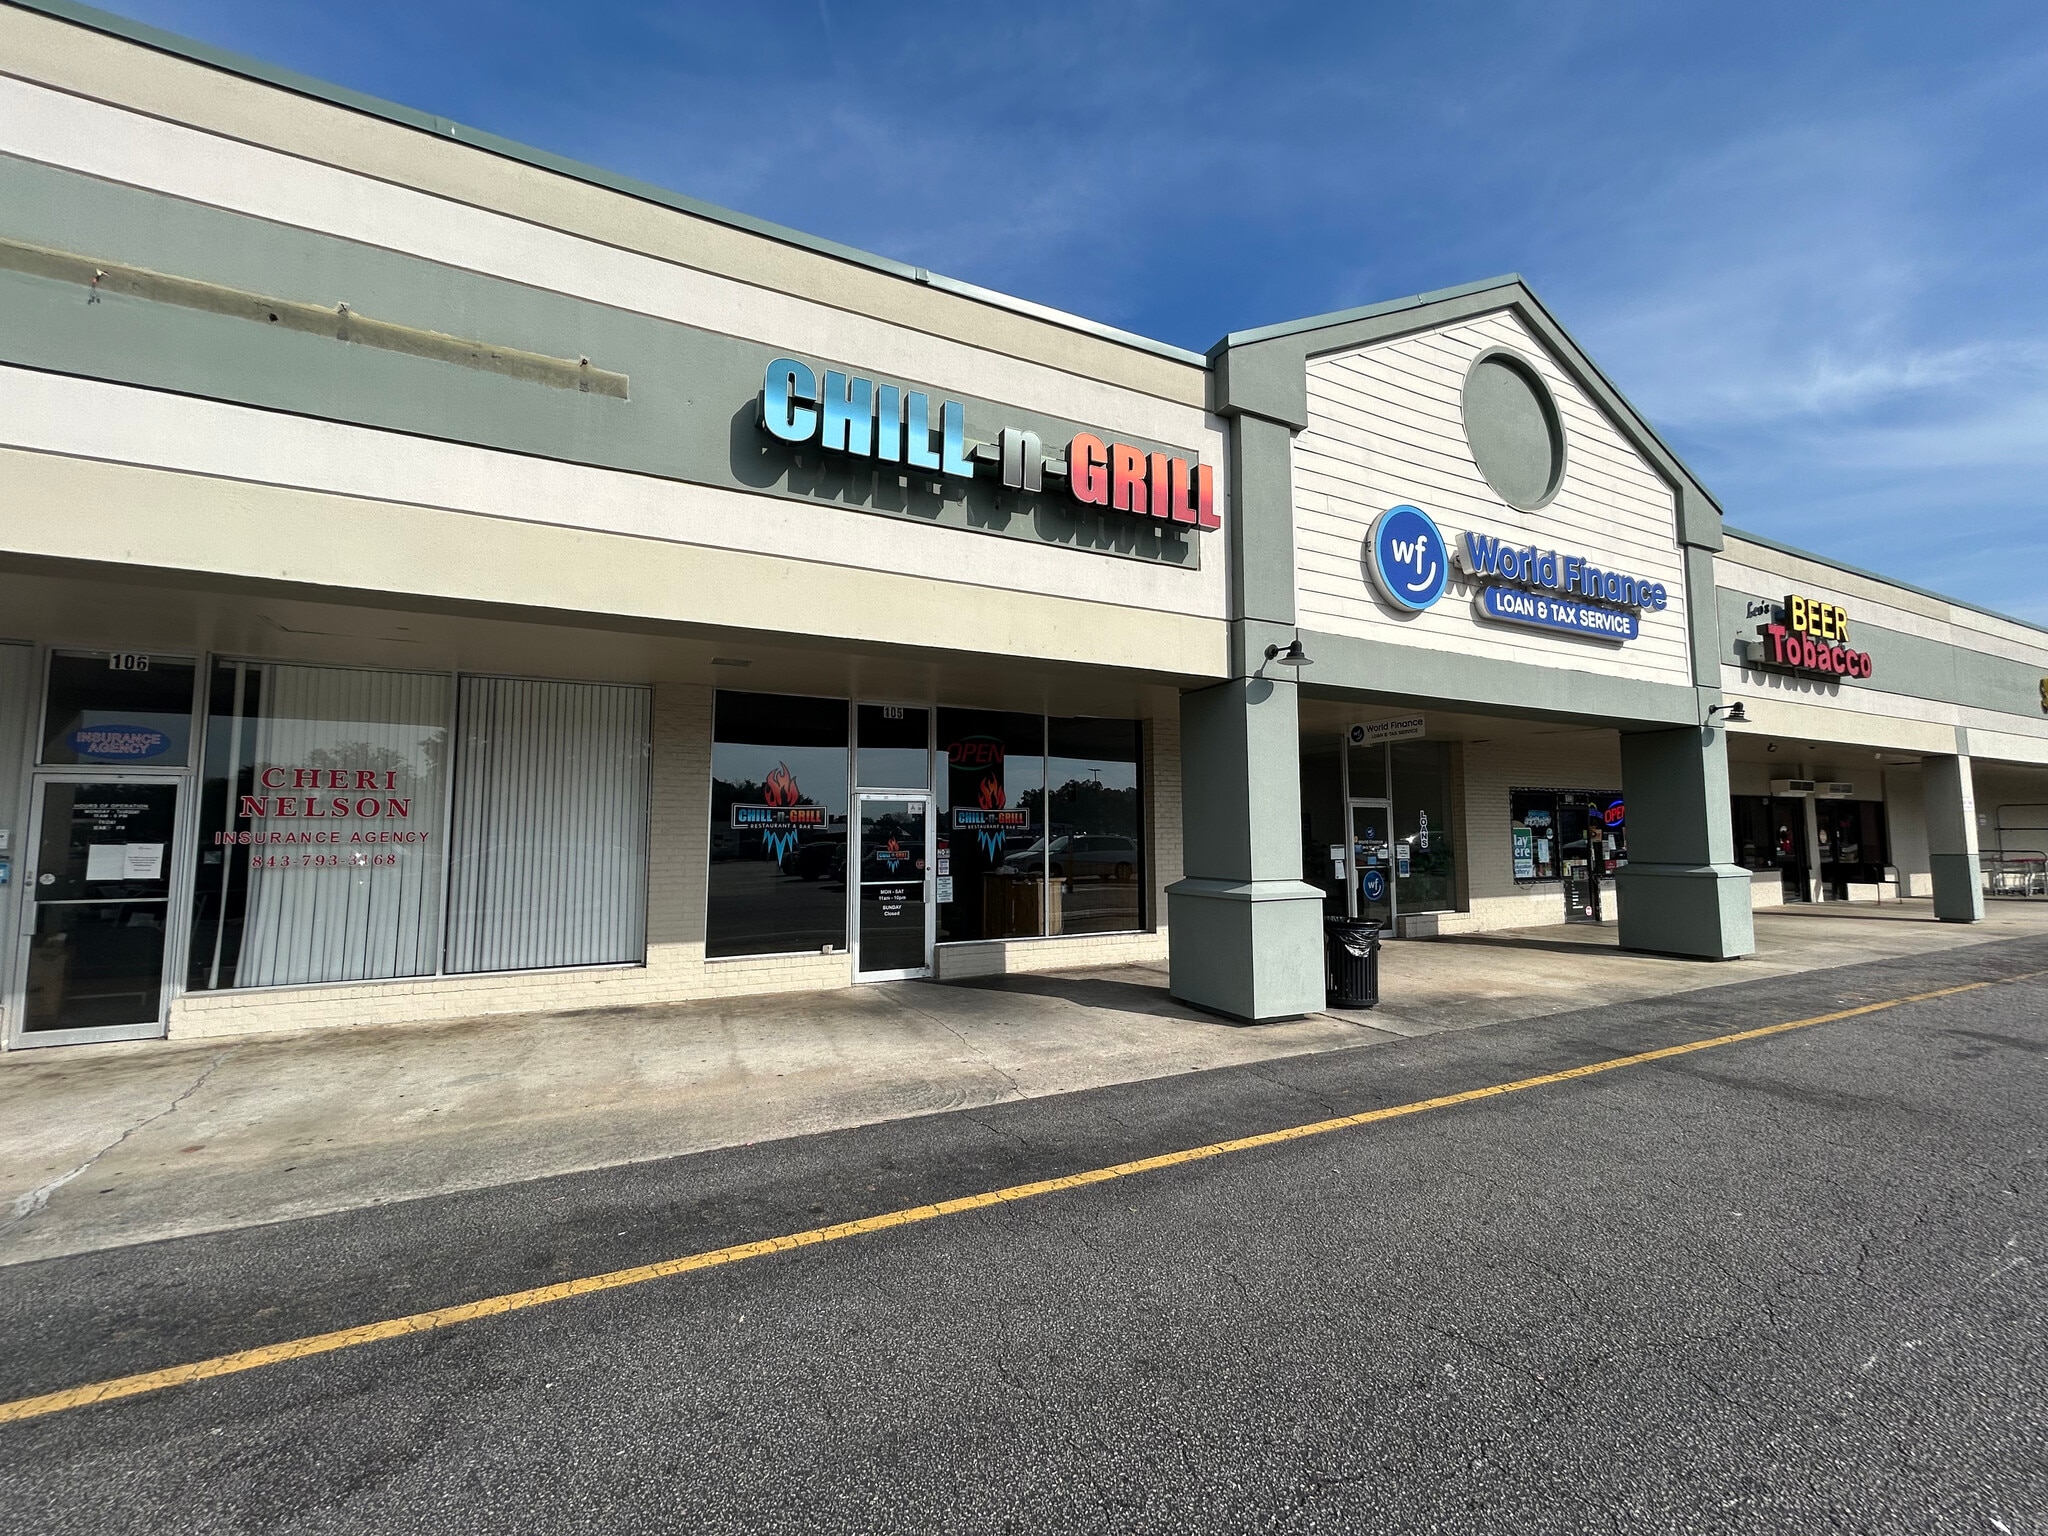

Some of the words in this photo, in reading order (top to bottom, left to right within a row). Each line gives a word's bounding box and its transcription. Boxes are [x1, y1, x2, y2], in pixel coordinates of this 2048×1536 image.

[1391, 535, 1428, 575] wf
[1461, 530, 1559, 589] World
[1565, 555, 1668, 611] Finance
[1495, 592, 1534, 614] LOAN
[1538, 603, 1549, 618] &
[1550, 603, 1577, 624] TAX
[1579, 609, 1631, 634] SERVICE
[1789, 594, 1850, 642] BEER
[1764, 623, 1873, 679] Tobacco
[113, 654, 148, 671] 106
[884, 706, 903, 719] 105
[1366, 722, 1389, 733] World
[1390, 718, 1424, 730] Finance
[76, 731, 162, 745] INSURANCE
[87, 742, 151, 754] AGENCY
[946, 743, 1005, 764] OPEN
[260, 767, 397, 791] CHERI
[239, 795, 411, 819] NELSON
[214, 831, 341, 845] INSURANCE
[349, 831, 430, 844] AGENCY
[1419, 809, 1429, 849] LOANS
[1367, 878, 1379, 891] wf
